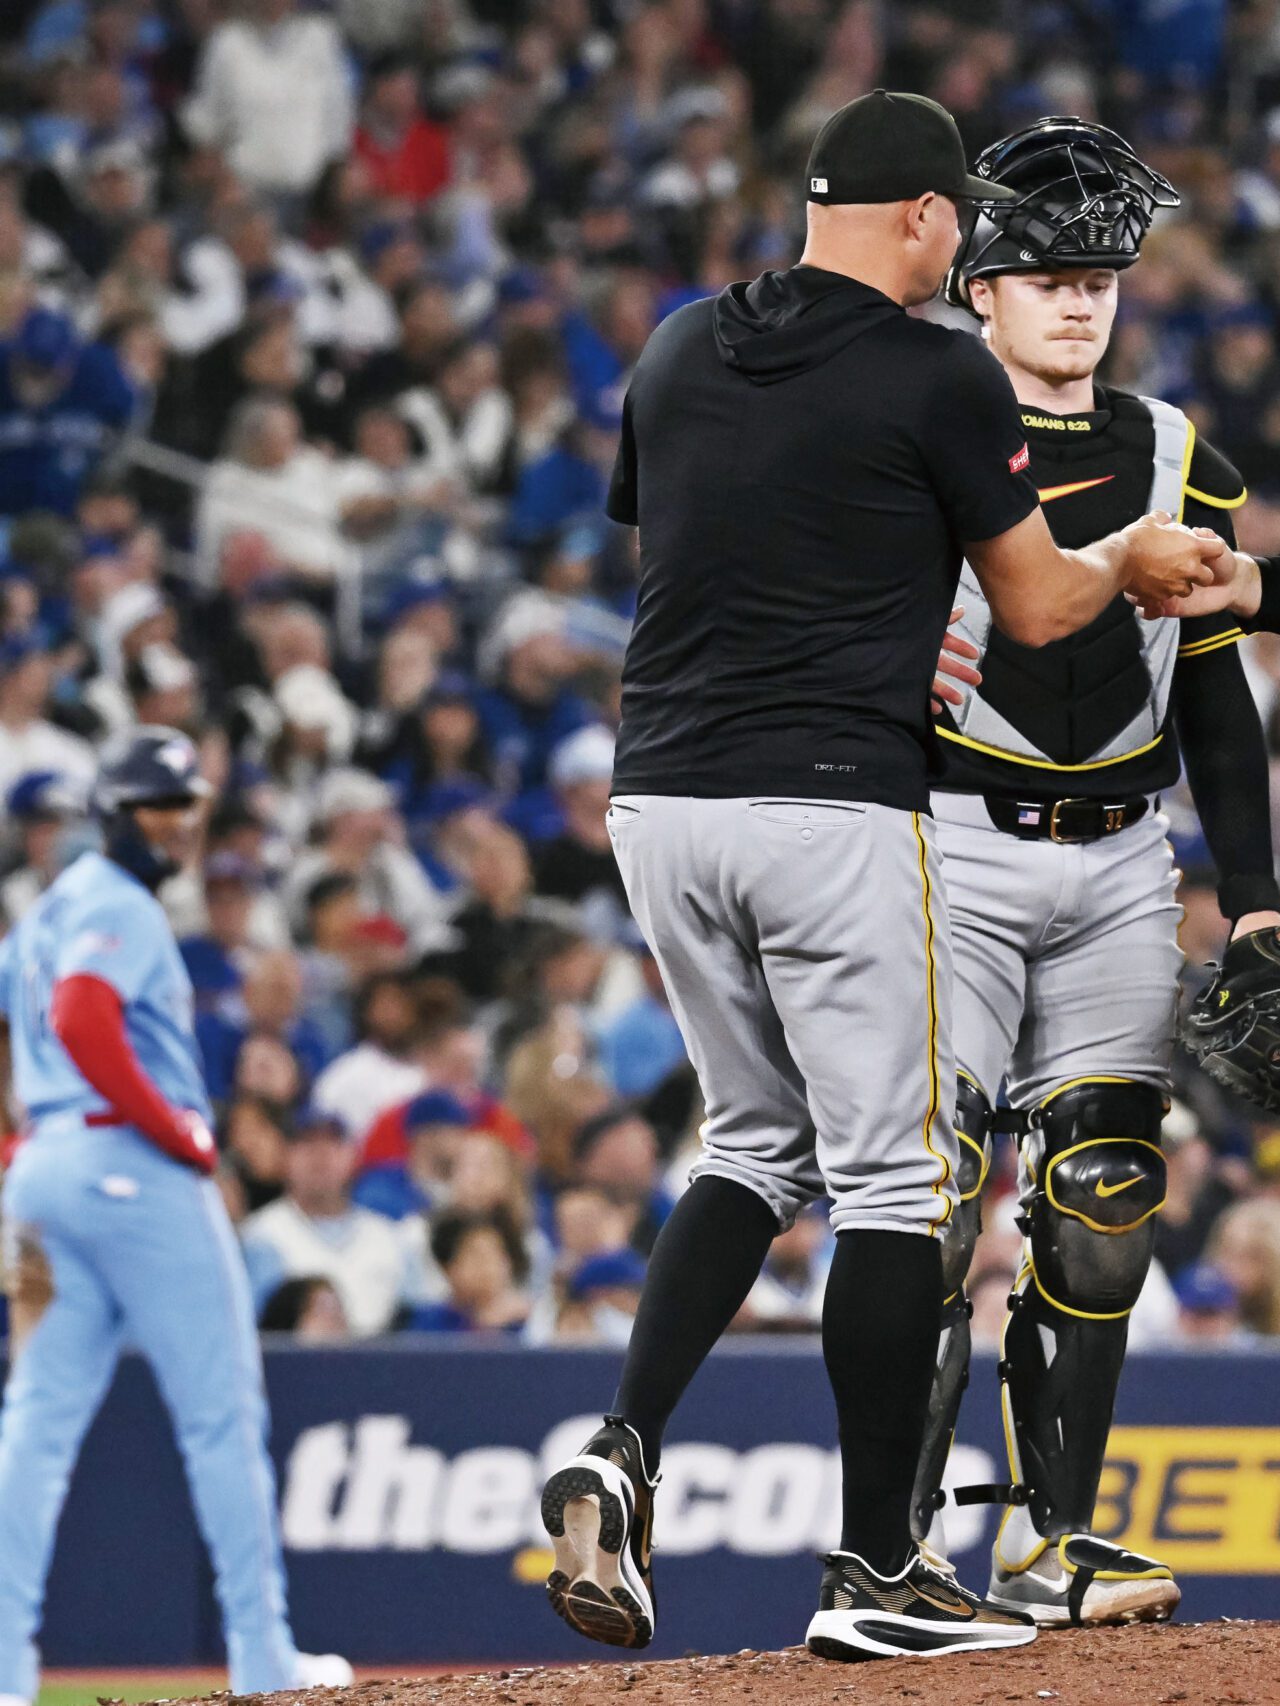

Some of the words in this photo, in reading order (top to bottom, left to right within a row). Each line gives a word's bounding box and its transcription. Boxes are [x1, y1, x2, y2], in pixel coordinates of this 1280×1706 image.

[1021, 414, 1066, 431] OMANS
[814, 763, 858, 772] DRI-FIT
[1105, 810, 1124, 832] 32
